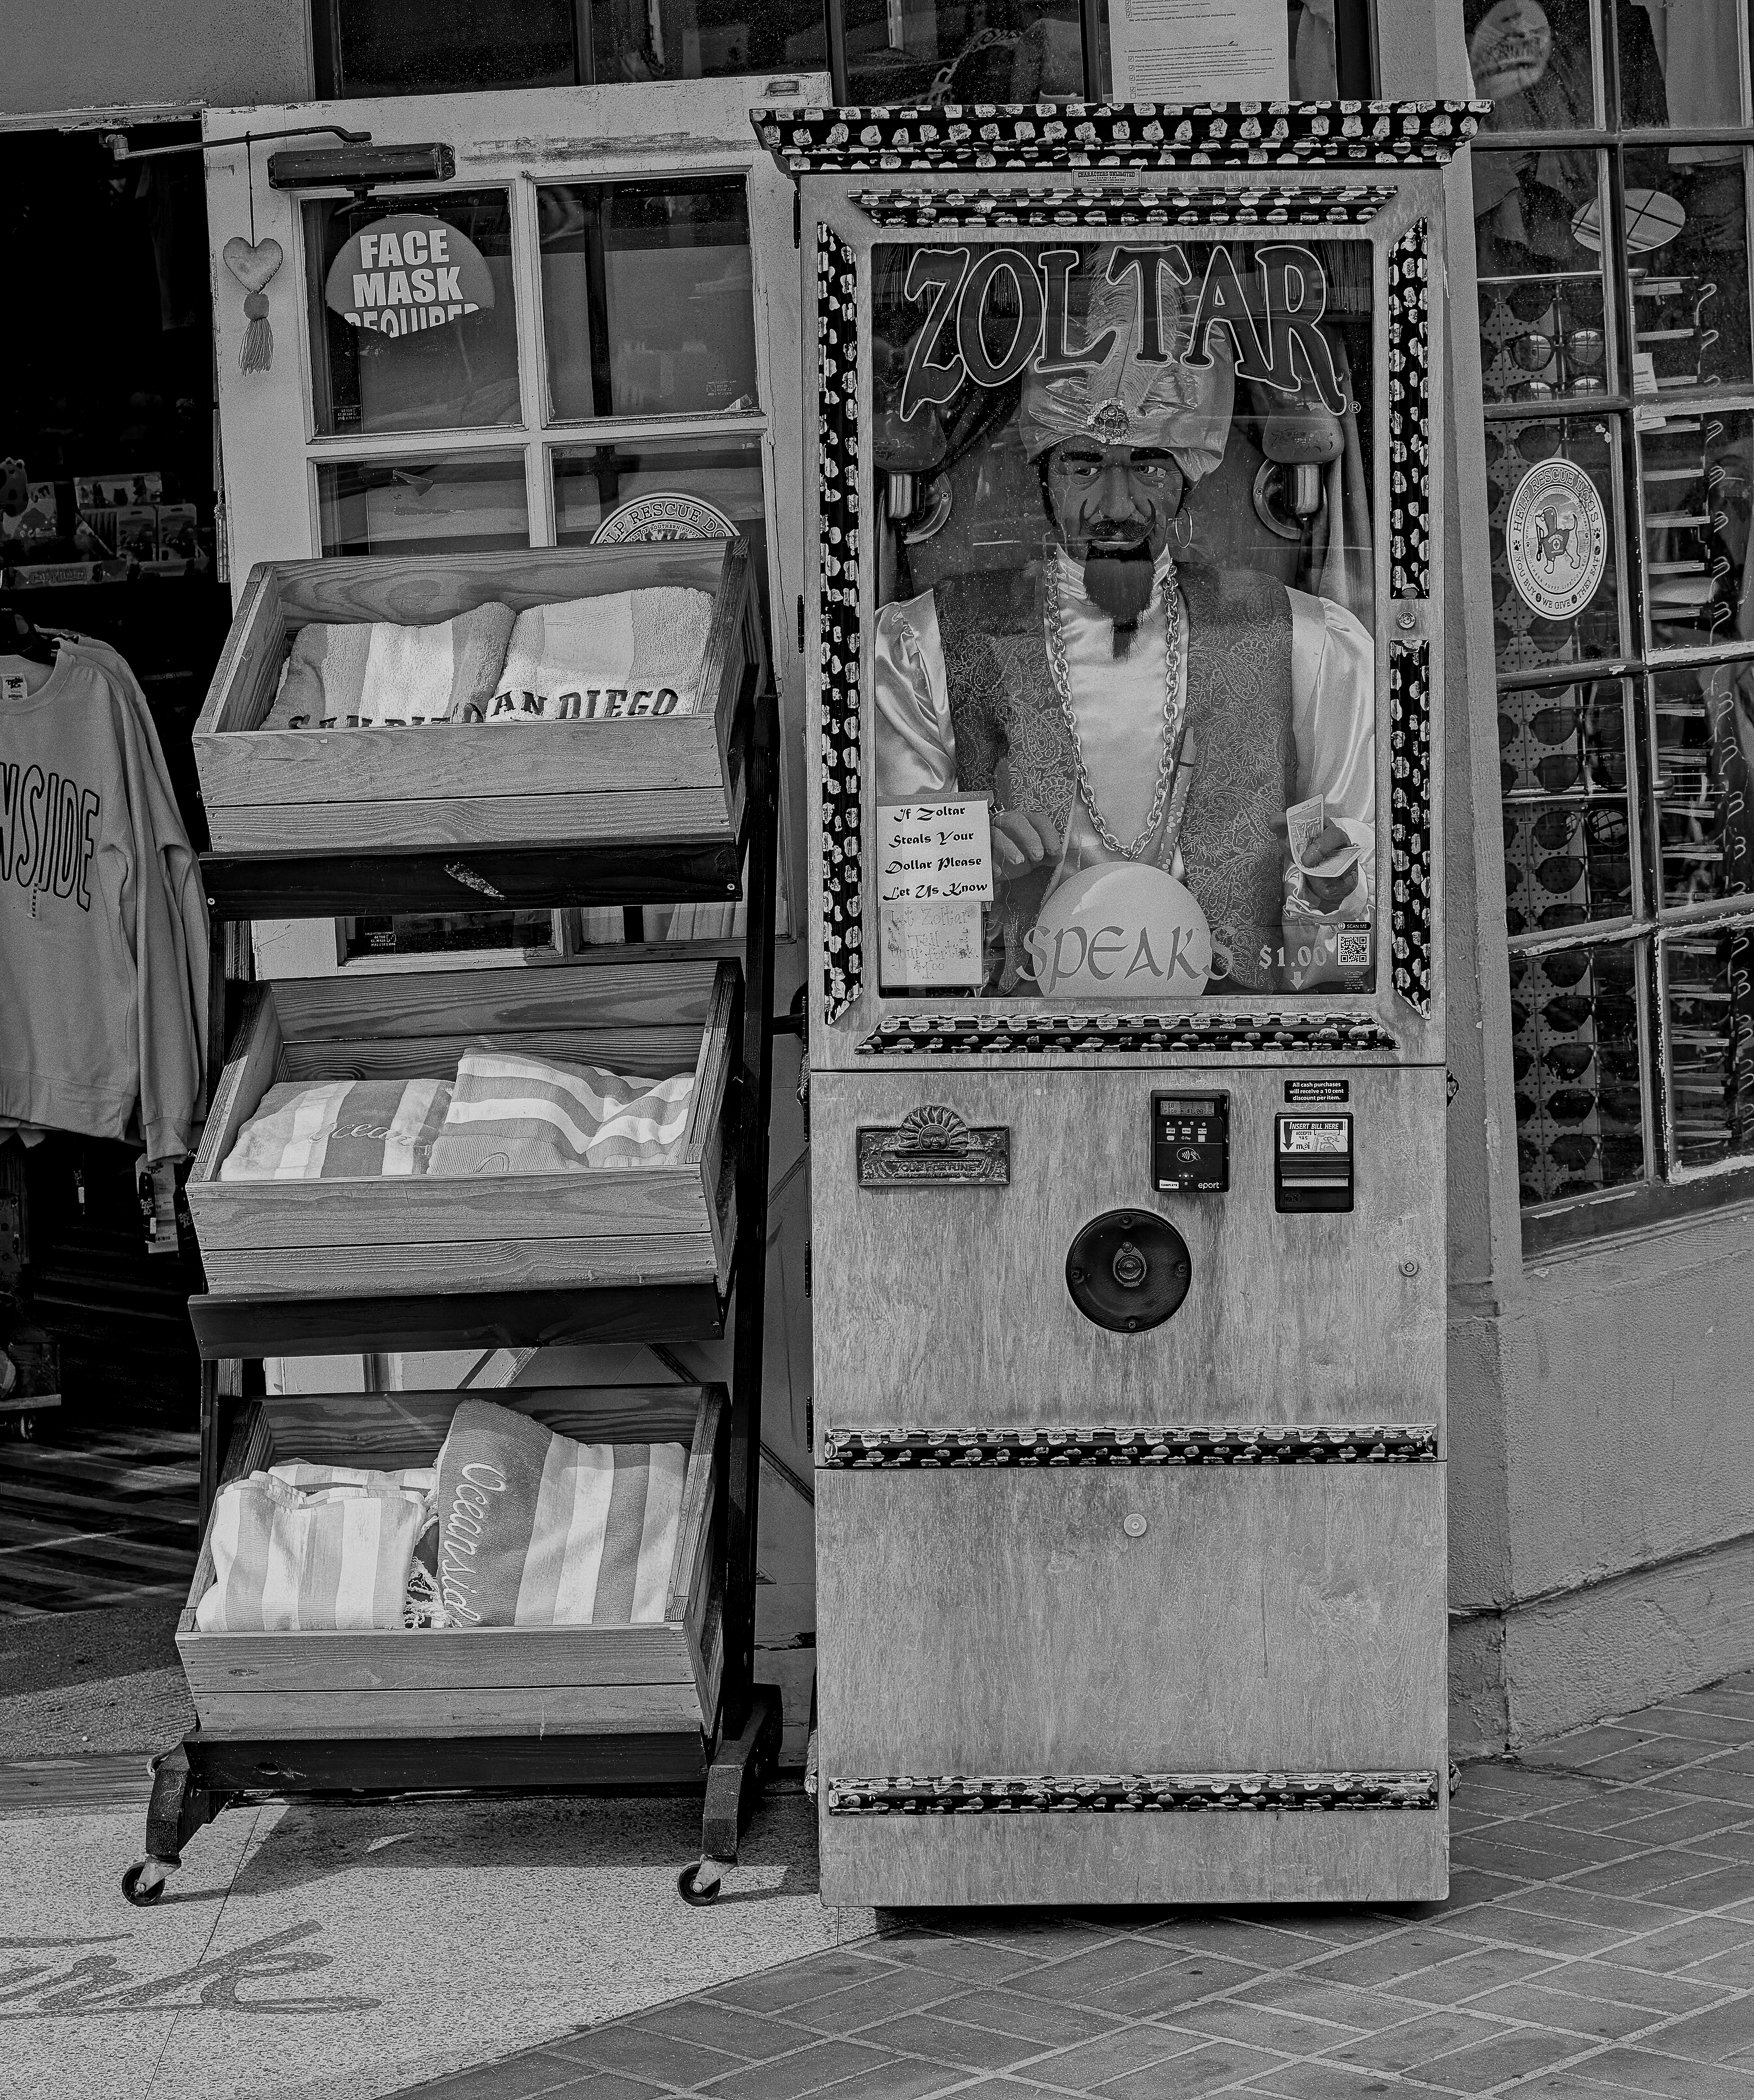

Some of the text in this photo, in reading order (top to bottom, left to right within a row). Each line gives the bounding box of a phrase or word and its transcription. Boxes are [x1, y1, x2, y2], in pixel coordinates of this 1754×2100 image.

[359, 229, 450, 269] FACE
[352, 266, 464, 308] MASK
[899, 245, 1347, 422] ZOLTAR
[629, 503, 702, 524] RESCUE
[1513, 489, 1532, 533] HELP
[1530, 468, 1575, 492] RESCUE
[1575, 476, 1600, 524] DOGS
[1514, 556, 1527, 579] YOU
[1523, 578, 1537, 598] BUY
[1542, 597, 1554, 610] WE
[1554, 596, 1572, 610] GIVE
[1576, 579, 1594, 601] THEY
[1590, 555, 1601, 578] EAT
[556, 687, 680, 720] DIEGO
[893, 806, 966, 823] If Zoltar
[888, 830, 974, 848] Steals Your
[884, 857, 982, 875] Dollar Please
[882, 882, 988, 901] Let Us Know
[1016, 925, 1234, 994] SPEAKS
[1259, 944, 1327, 970] $1.00
[1289, 1121, 1339, 1130] INSERT BILL HERE
[1198, 1181, 1220, 1189] eport
